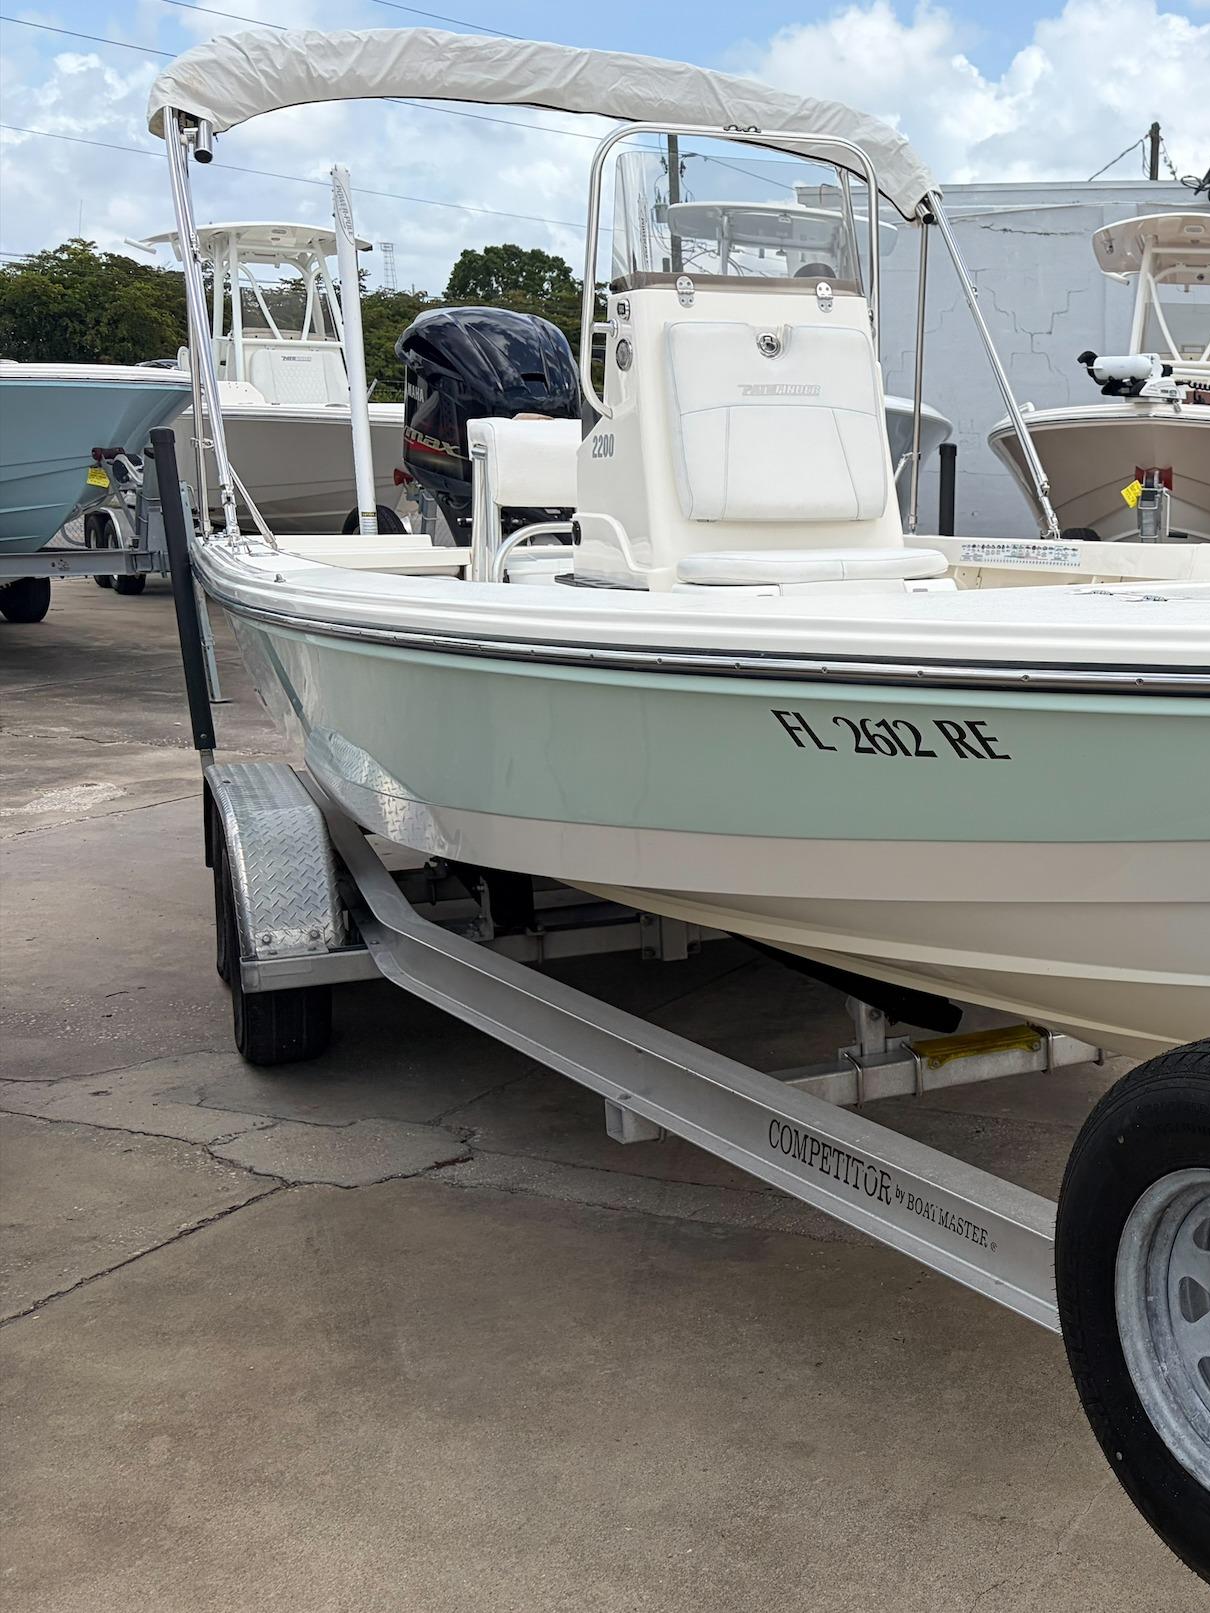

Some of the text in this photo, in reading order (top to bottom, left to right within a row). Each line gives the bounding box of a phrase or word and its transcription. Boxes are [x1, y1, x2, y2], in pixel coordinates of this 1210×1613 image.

[592, 433, 615, 458] 2200
[770, 709, 1012, 760] FL 2612 RE
[768, 1119, 892, 1206] COMPETITOR
[895, 1184, 906, 1204] by
